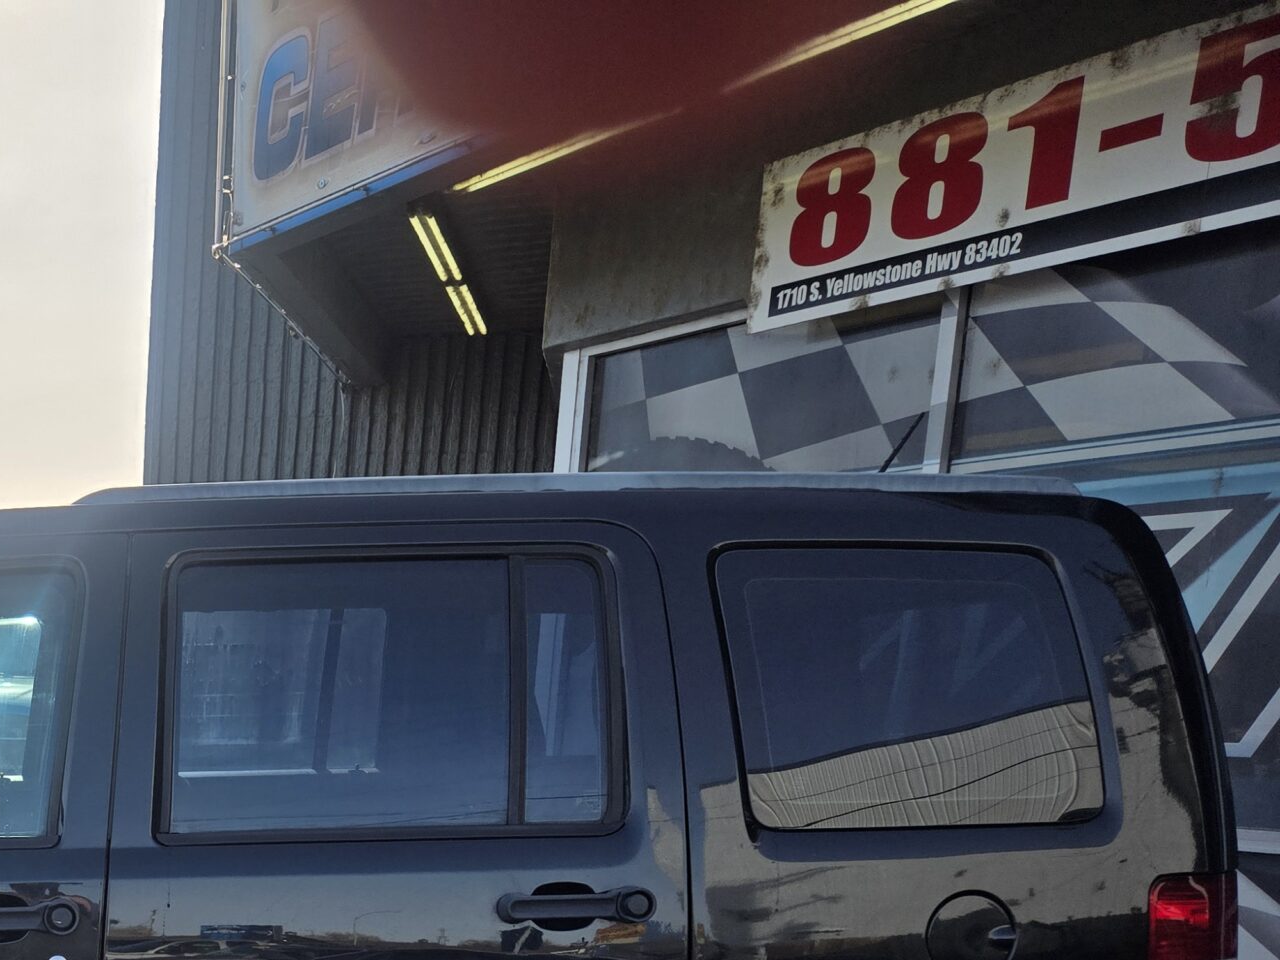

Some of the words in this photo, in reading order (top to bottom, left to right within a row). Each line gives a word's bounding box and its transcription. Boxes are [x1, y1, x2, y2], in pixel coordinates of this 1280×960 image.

[789, 13, 1280, 267] 881-5
[776, 284, 807, 310] 1710
[809, 281, 822, 302] S.
[826, 259, 922, 297] Yellowstone
[924, 249, 962, 275] Hwy
[964, 232, 1023, 265] 83402
